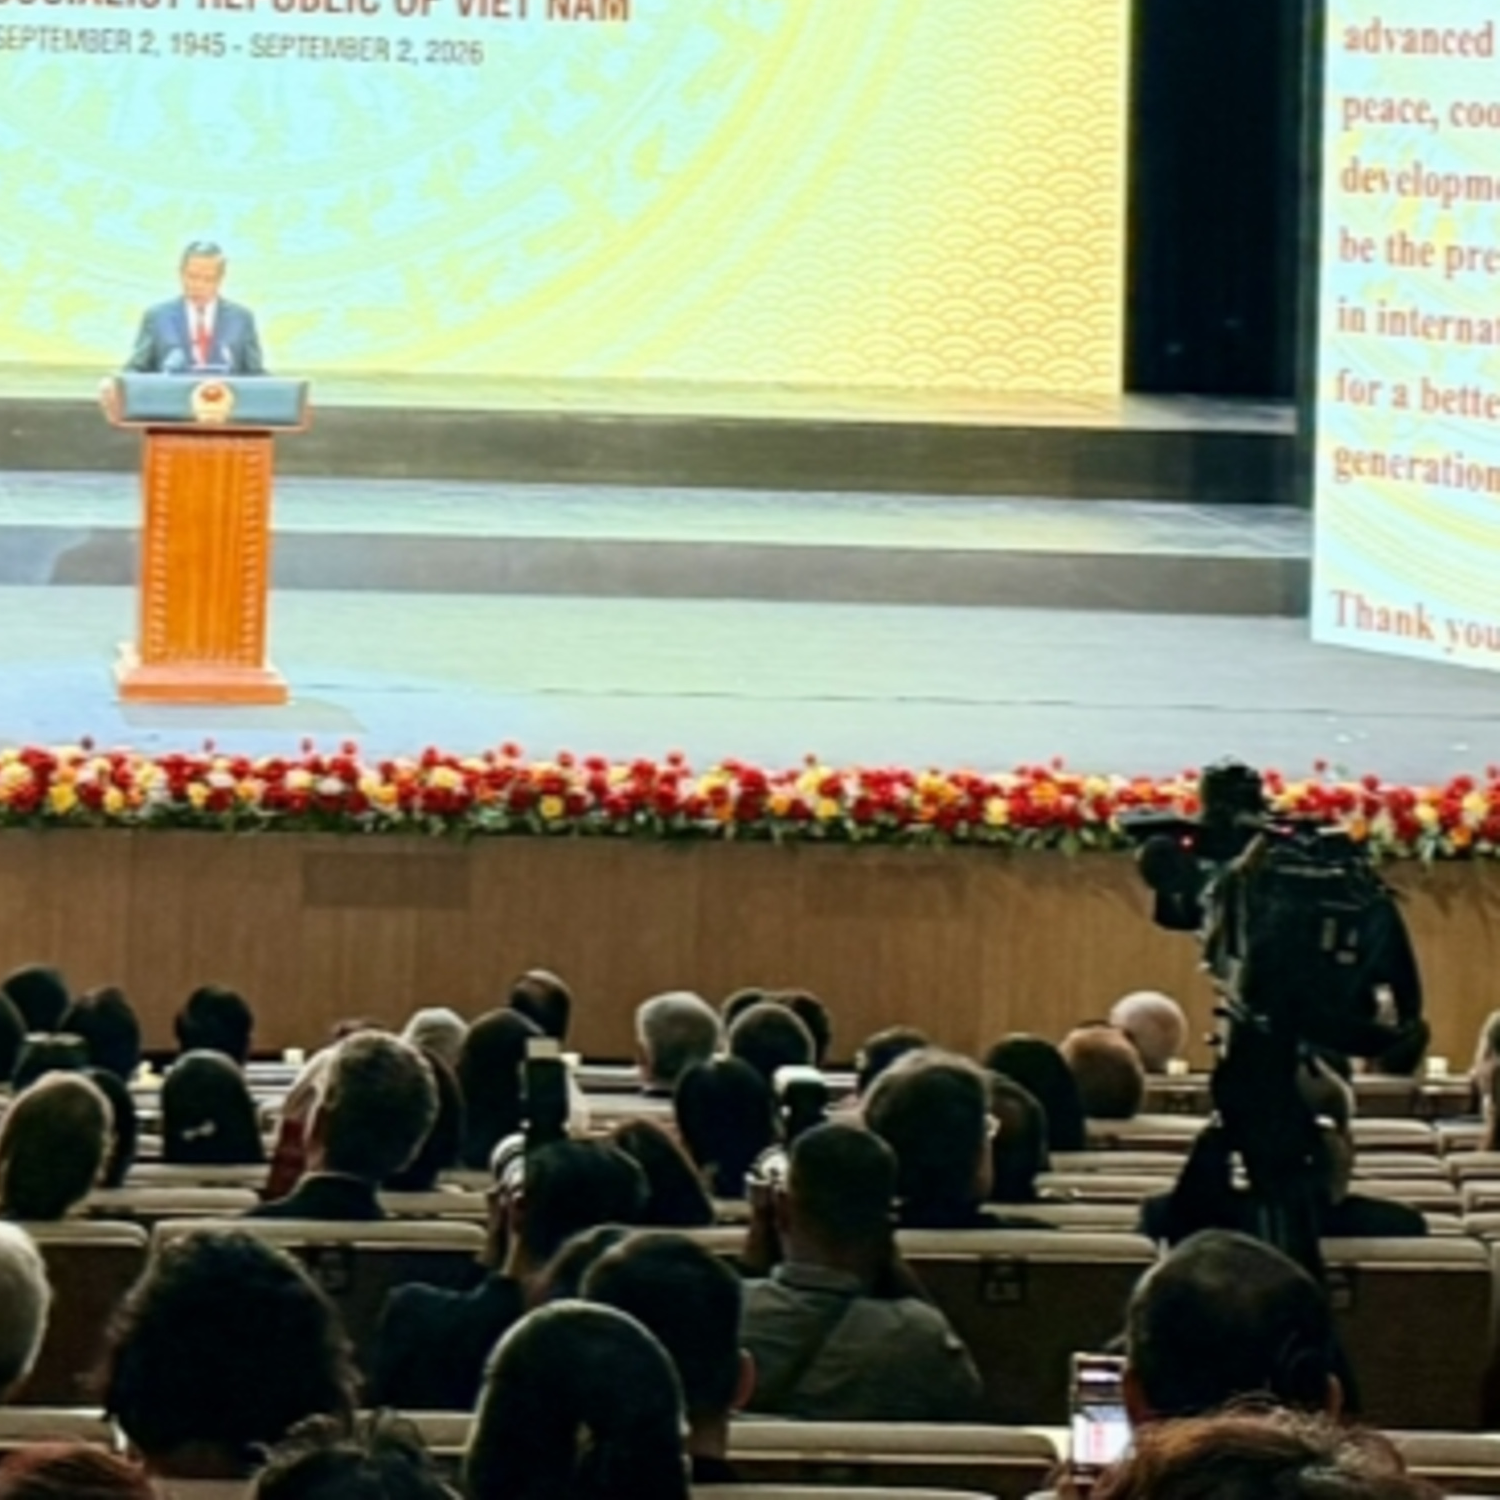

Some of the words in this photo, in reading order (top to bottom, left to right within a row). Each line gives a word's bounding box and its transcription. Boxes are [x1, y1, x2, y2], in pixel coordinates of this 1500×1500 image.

[138, 28, 162, 59] 2,
[171, 29, 227, 58] 1945
[248, 32, 390, 63] SEPTEMBER
[396, 37, 420, 66] 2,
[425, 36, 485, 65] 2026
[1344, 16, 1495, 58] advanced
[1343, 96, 1439, 133] peace,
[1339, 227, 1374, 263] be
[1385, 230, 1435, 268] the
[1337, 296, 1366, 333] in
[1336, 368, 1382, 406] for
[1391, 382, 1408, 409] a
[1330, 588, 1435, 641] Thank
